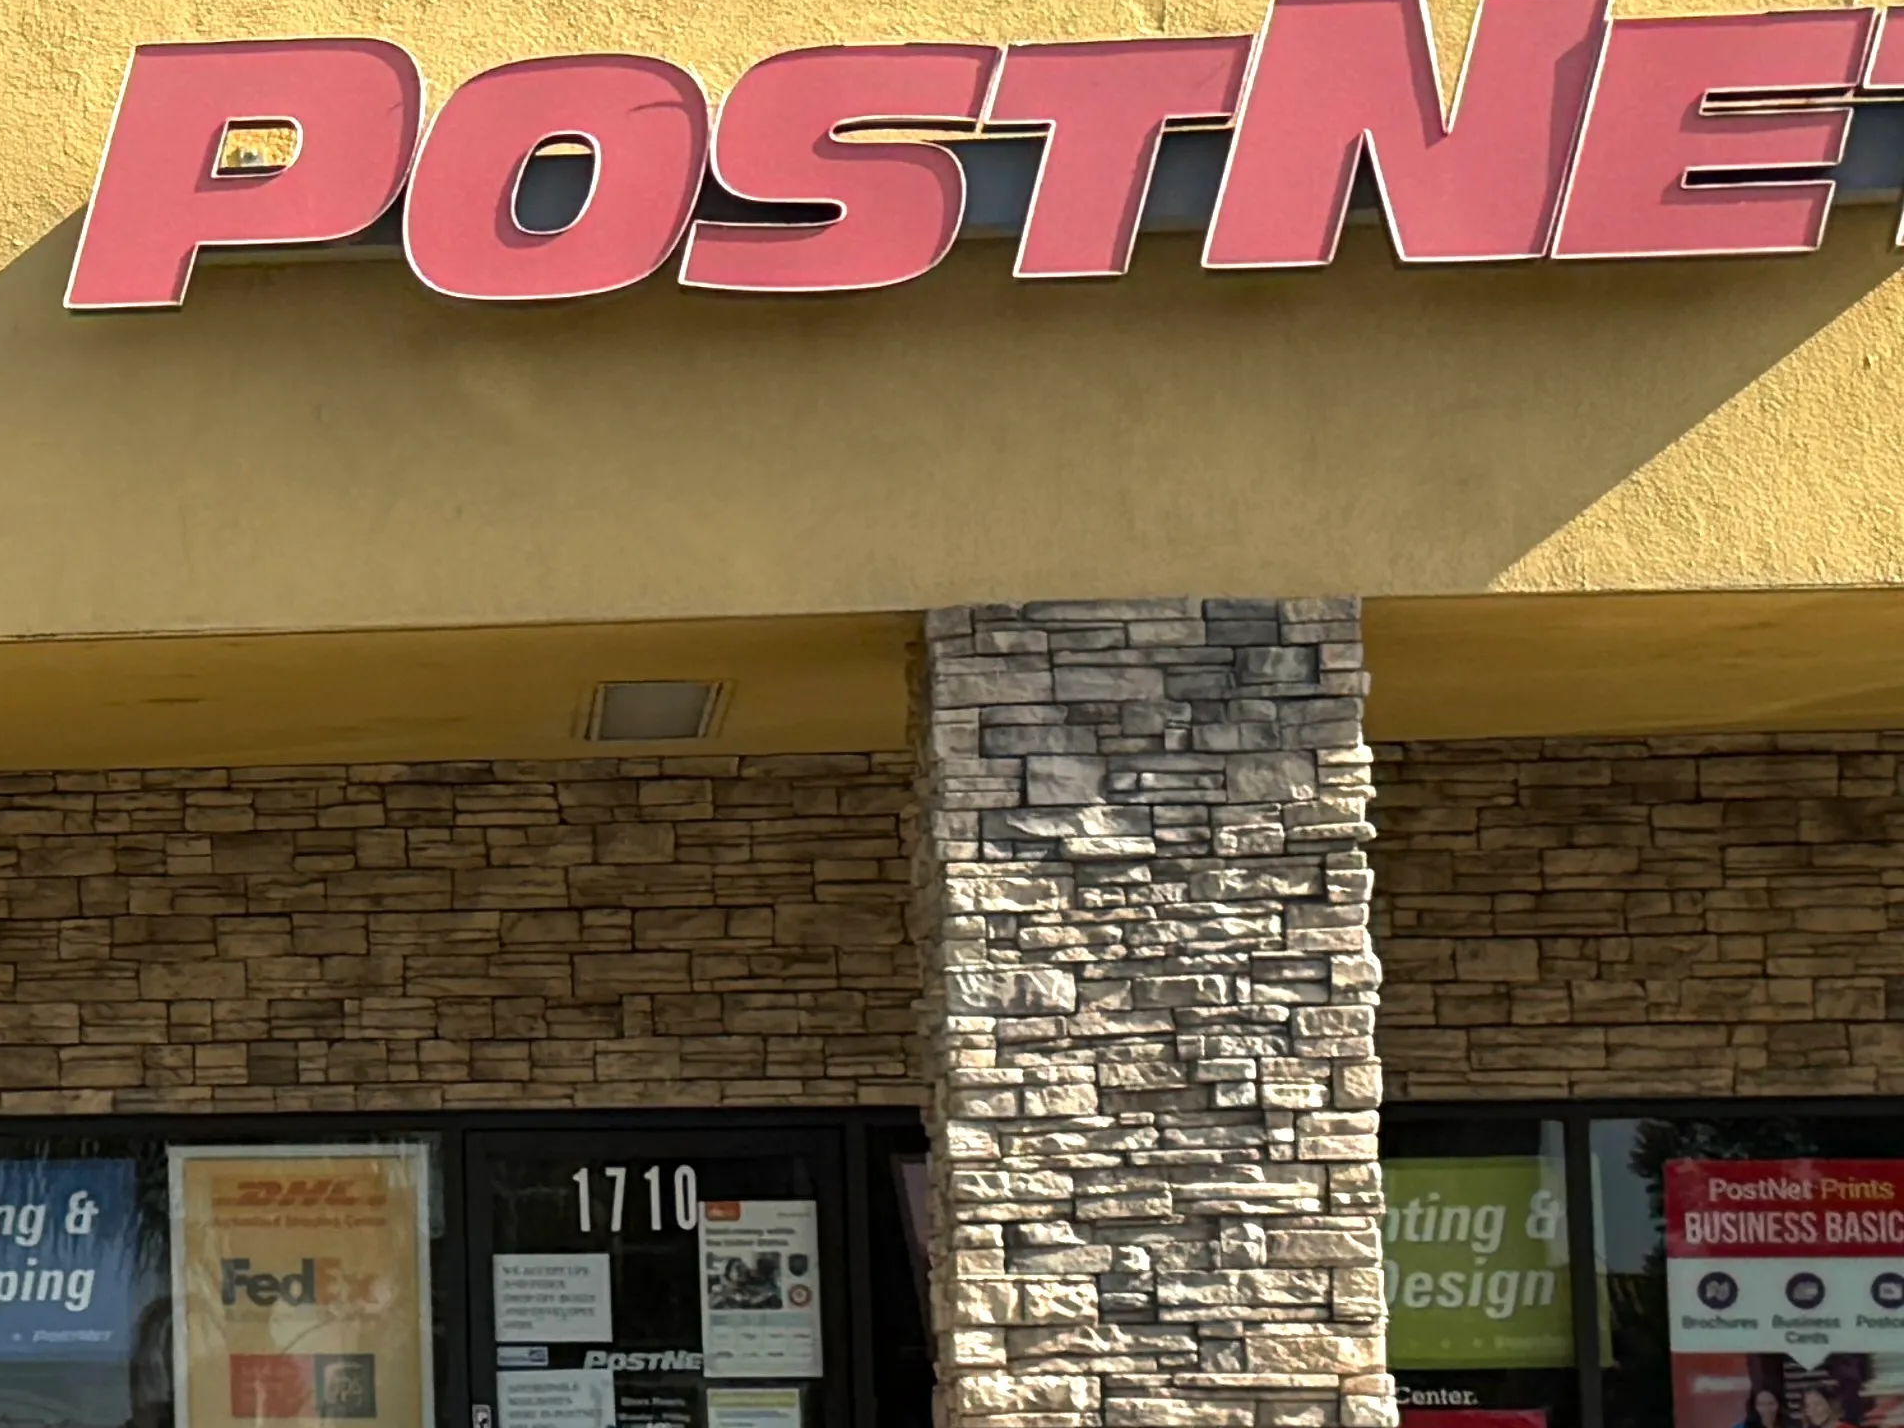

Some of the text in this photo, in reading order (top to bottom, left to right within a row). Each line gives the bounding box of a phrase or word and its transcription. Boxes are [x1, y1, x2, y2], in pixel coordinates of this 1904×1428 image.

[236, 1180, 358, 1206] DHL
[572, 1164, 697, 1232] 1710
[1708, 1177, 1895, 1201] PostNet Prints
[65, 1190, 99, 1235] &
[1525, 1189, 1560, 1239] &
[1685, 1211, 1817, 1244] BUSINESS
[221, 1257, 380, 1307] FedEx
[1681, 1315, 1759, 1329] Brochures
[1772, 1314, 1841, 1329] Business
[1785, 1331, 1829, 1345] Cards
